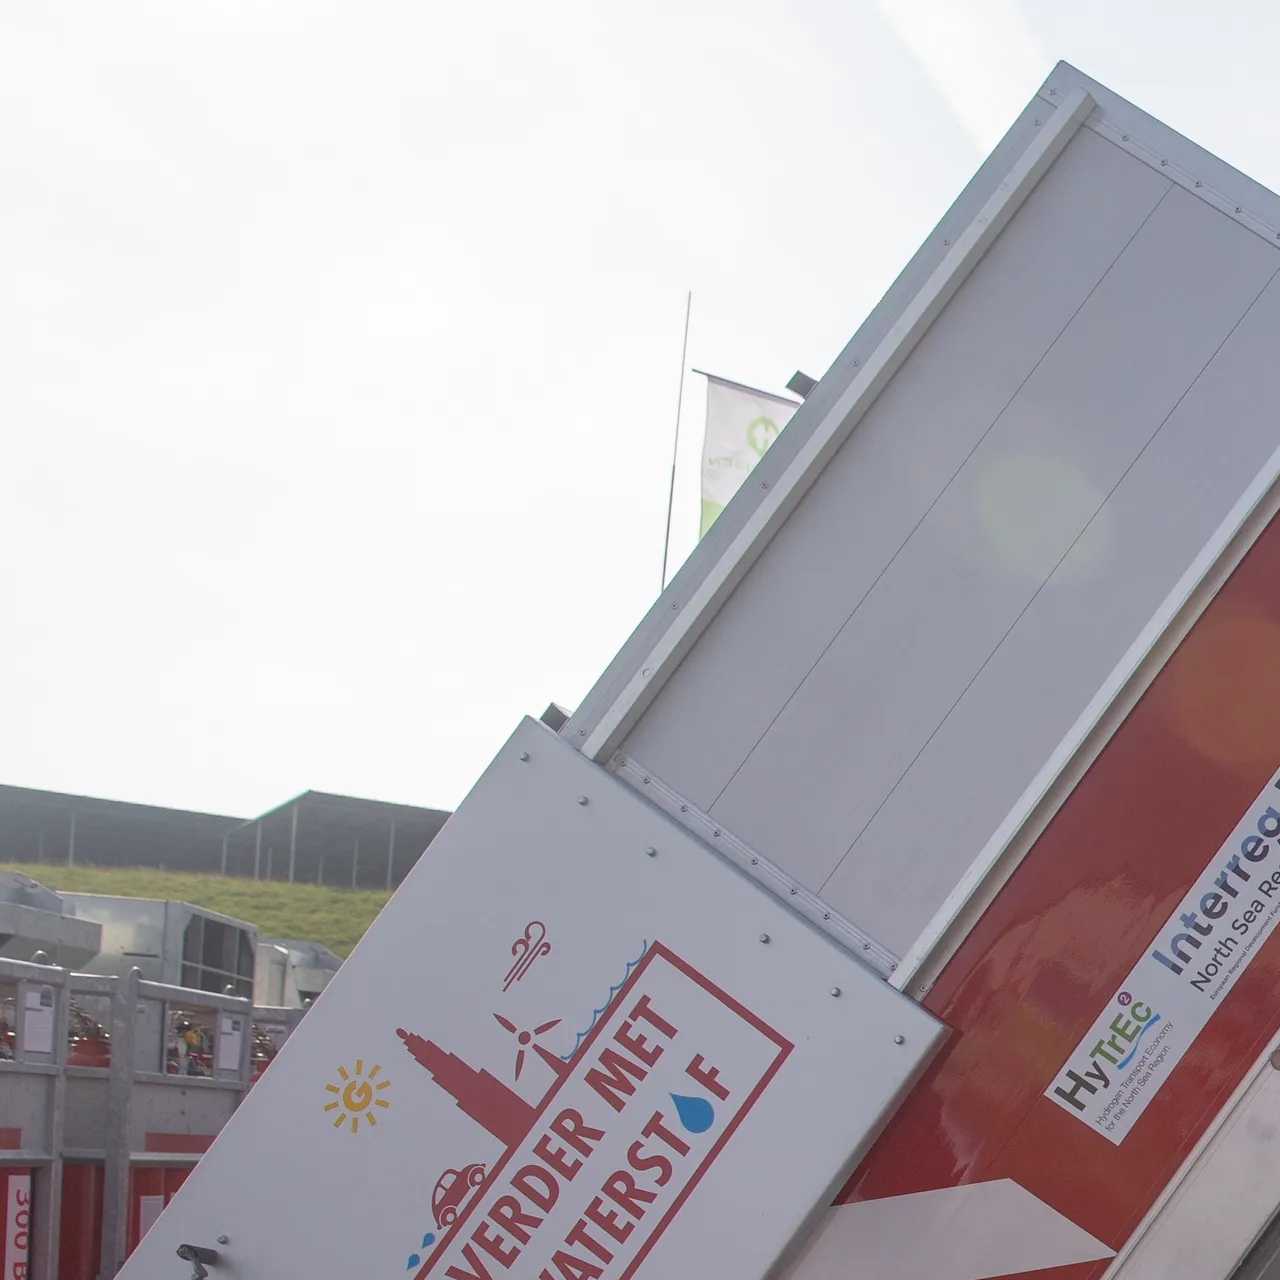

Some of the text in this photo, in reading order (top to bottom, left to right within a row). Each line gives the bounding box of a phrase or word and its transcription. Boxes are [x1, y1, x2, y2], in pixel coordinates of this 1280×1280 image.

[1189, 936, 1239, 993] North
[1232, 899, 1266, 935] Sea
[1209, 974, 1231, 1000] European
[1227, 950, 1247, 974] Regional
[1245, 915, 1273, 951] Development
[584, 993, 678, 1113] MET
[1095, 1021, 1174, 1126] Hydrogen Transport Economy
[1105, 1045, 1171, 1132] for the North Sea Region
